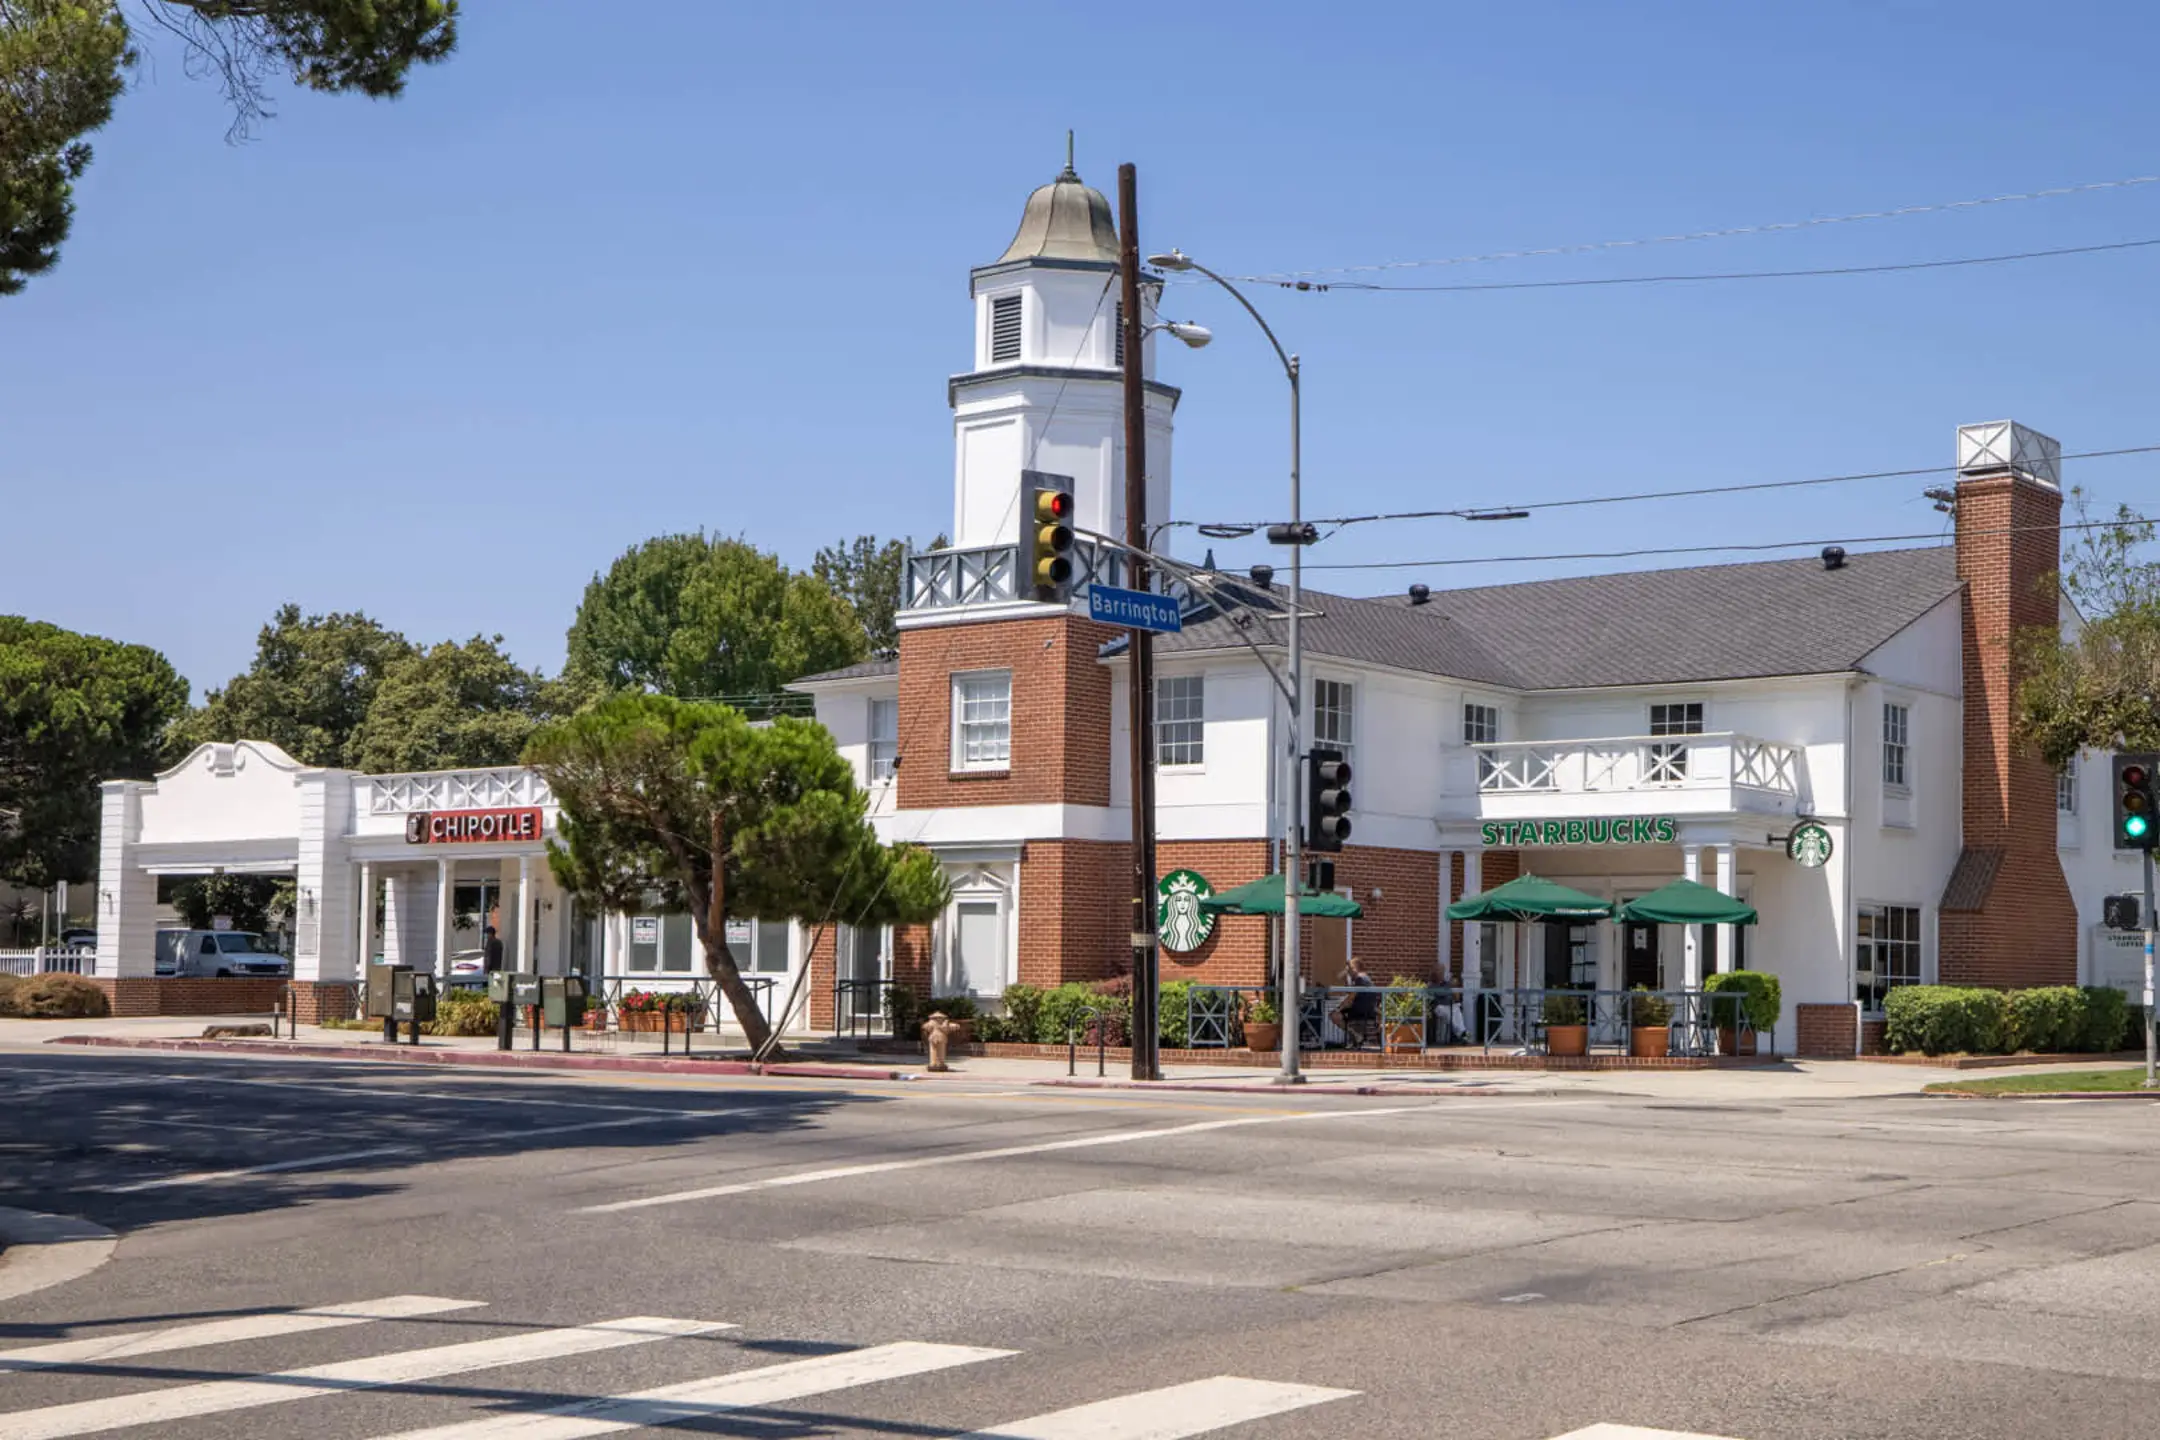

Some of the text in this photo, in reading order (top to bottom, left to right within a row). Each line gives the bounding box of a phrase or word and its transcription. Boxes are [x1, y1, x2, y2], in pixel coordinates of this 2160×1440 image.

[1092, 592, 1177, 626] Barrington
[431, 813, 532, 837] CHIPOTLE
[1481, 816, 1676, 845] STARBUCKS
